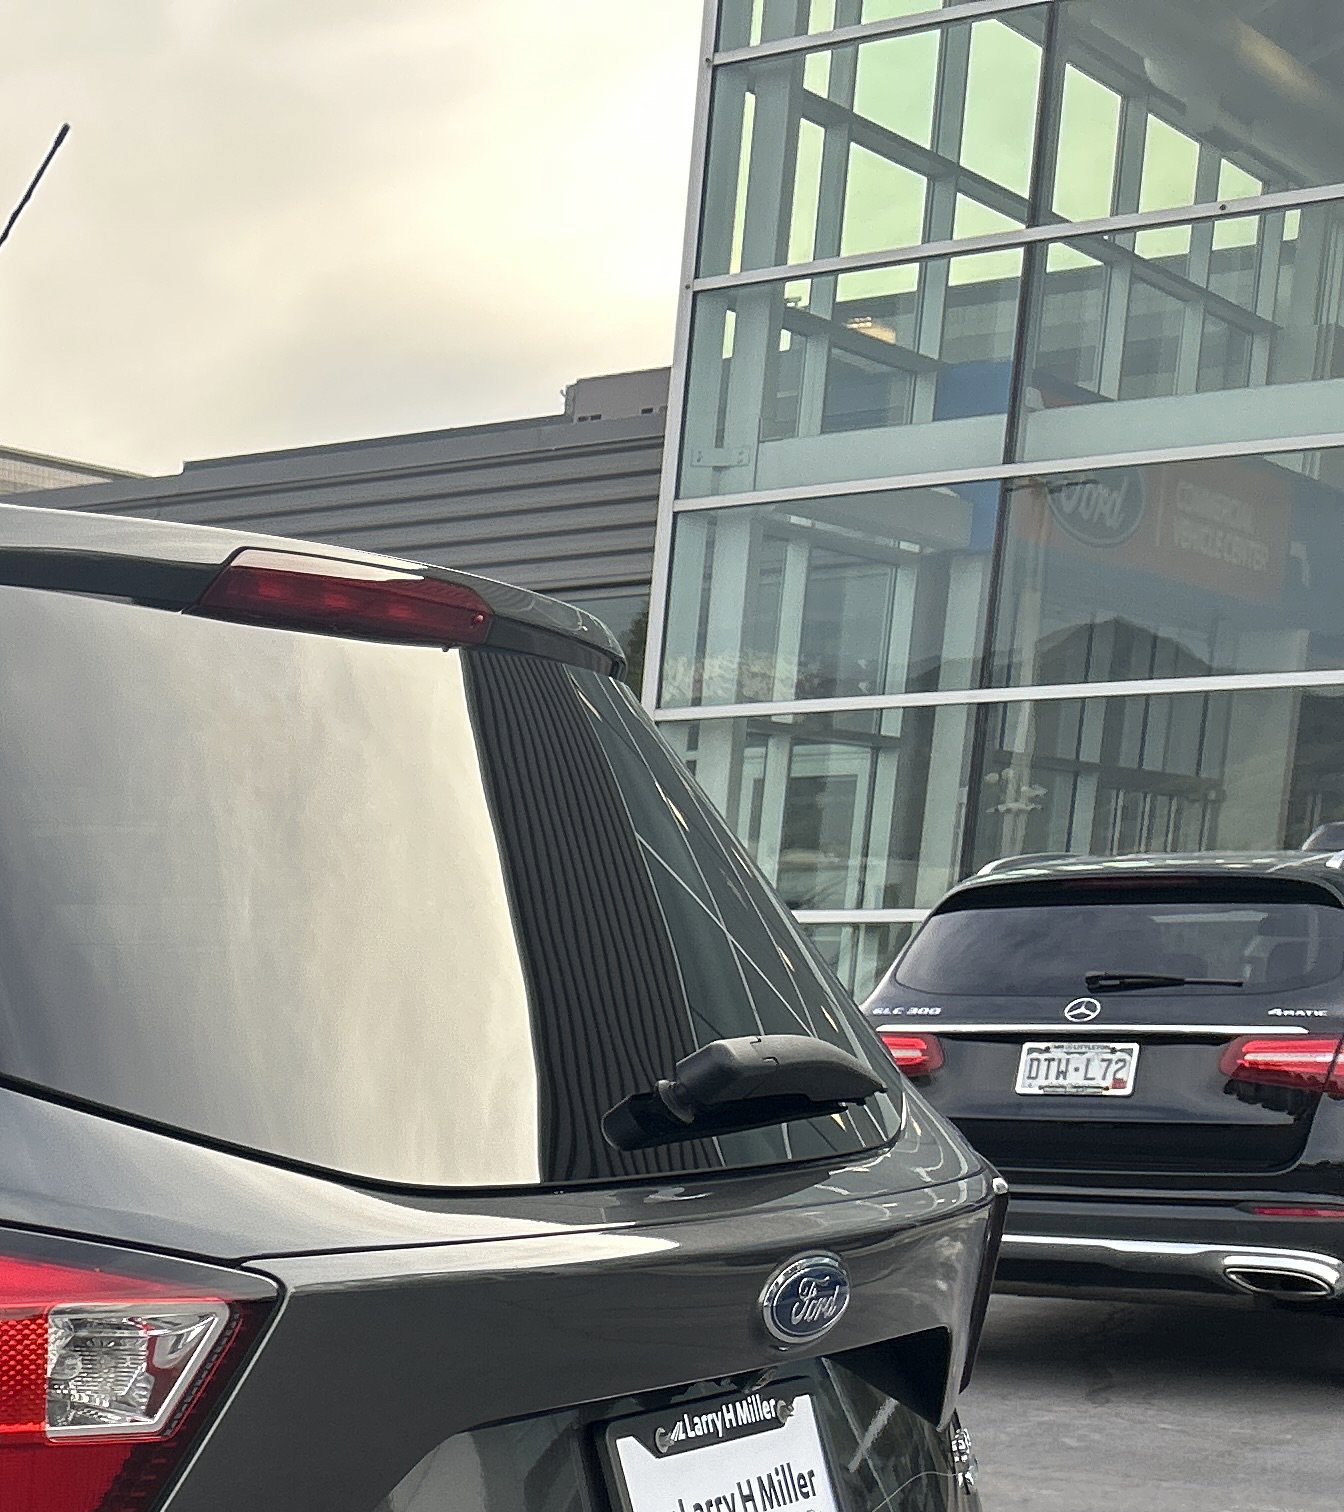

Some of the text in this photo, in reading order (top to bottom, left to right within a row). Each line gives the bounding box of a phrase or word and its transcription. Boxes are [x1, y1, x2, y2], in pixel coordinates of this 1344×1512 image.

[906, 1006, 942, 1015] 300
[790, 1275, 841, 1326] Ford
[683, 1393, 777, 1439] Larry H Miller
[756, 1461, 818, 1512] Miller
